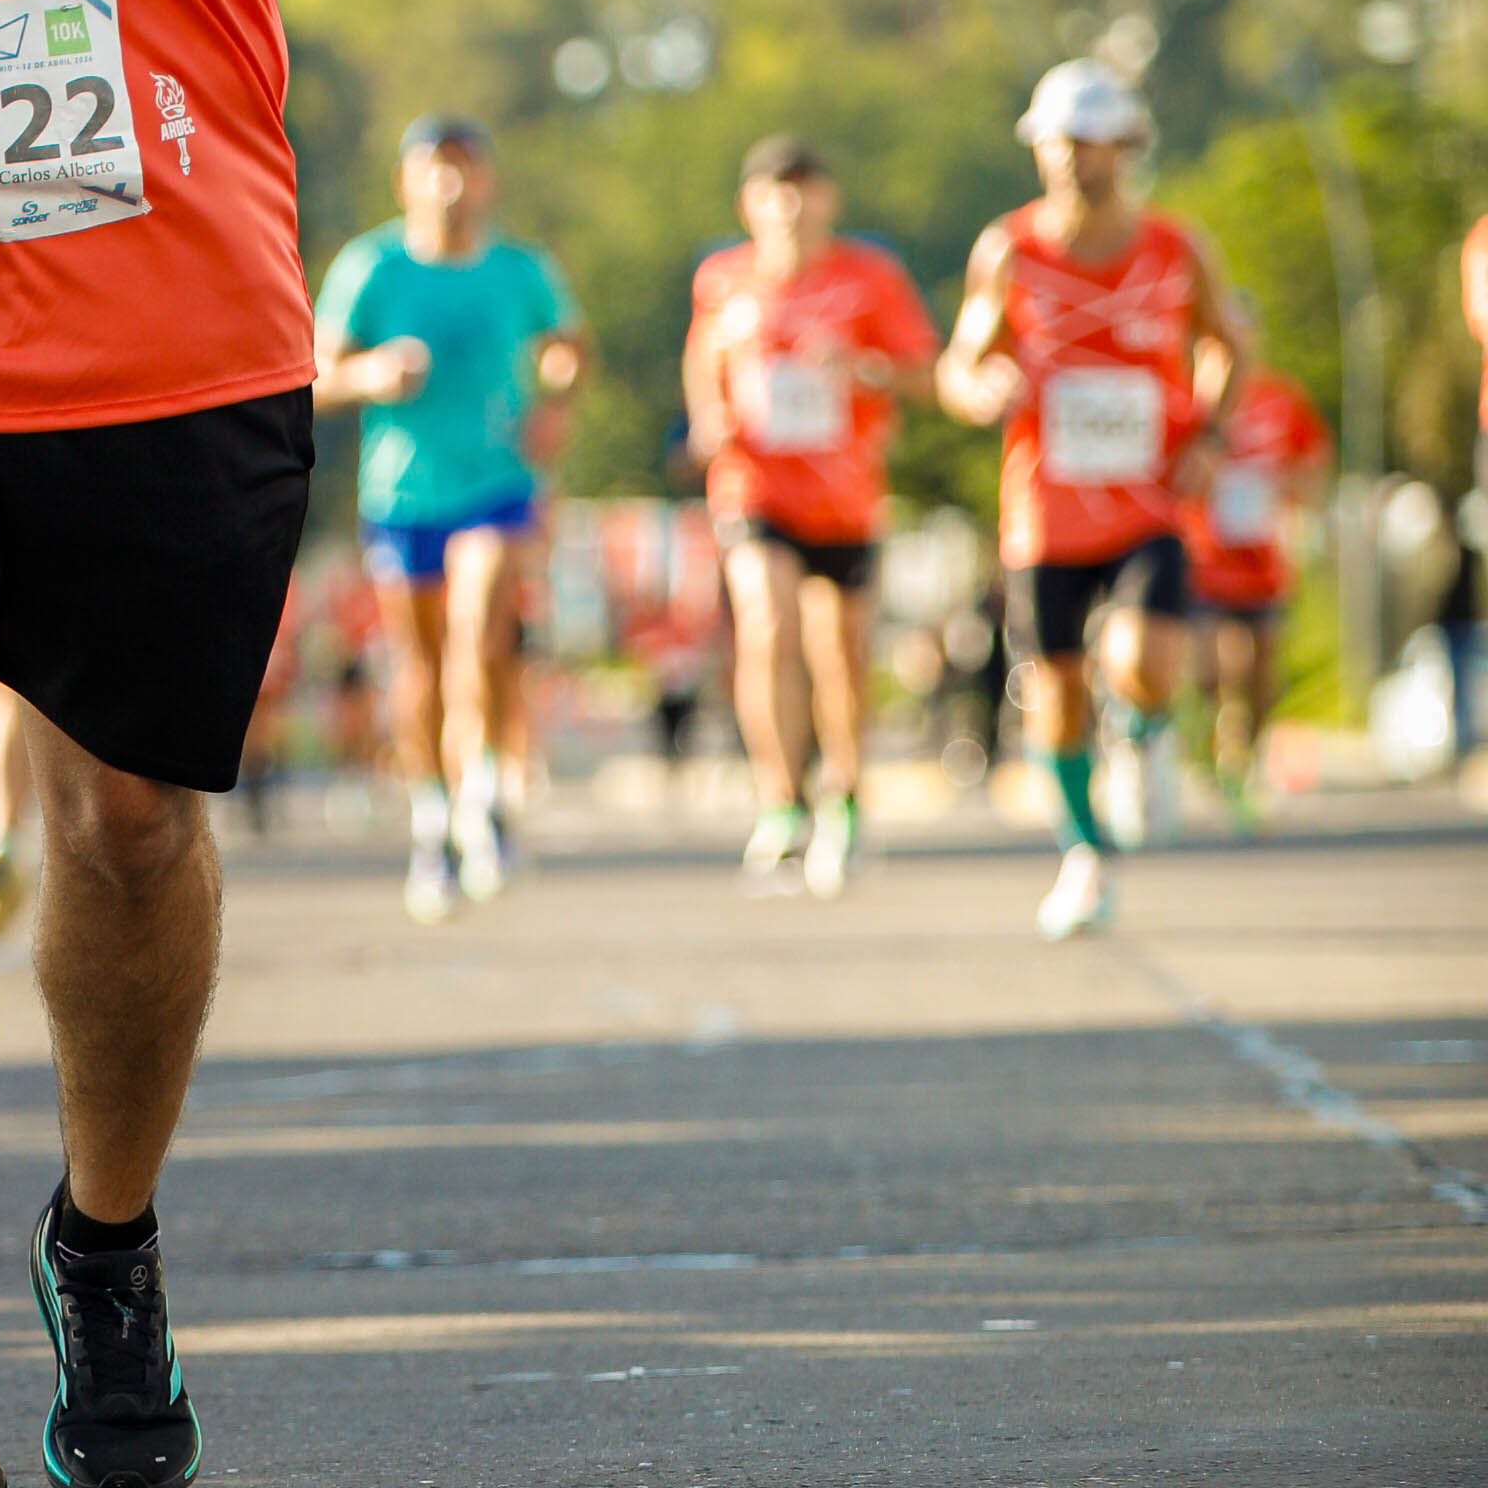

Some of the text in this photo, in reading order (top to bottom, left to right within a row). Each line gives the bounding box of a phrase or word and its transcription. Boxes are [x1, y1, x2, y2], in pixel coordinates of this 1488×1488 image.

[49, 20, 86, 42] 10K
[34, 61, 44, 69] DE
[47, 57, 72, 67] ABRIL
[160, 116, 196, 142] ARDEC
[55, 160, 115, 179] Alberto
